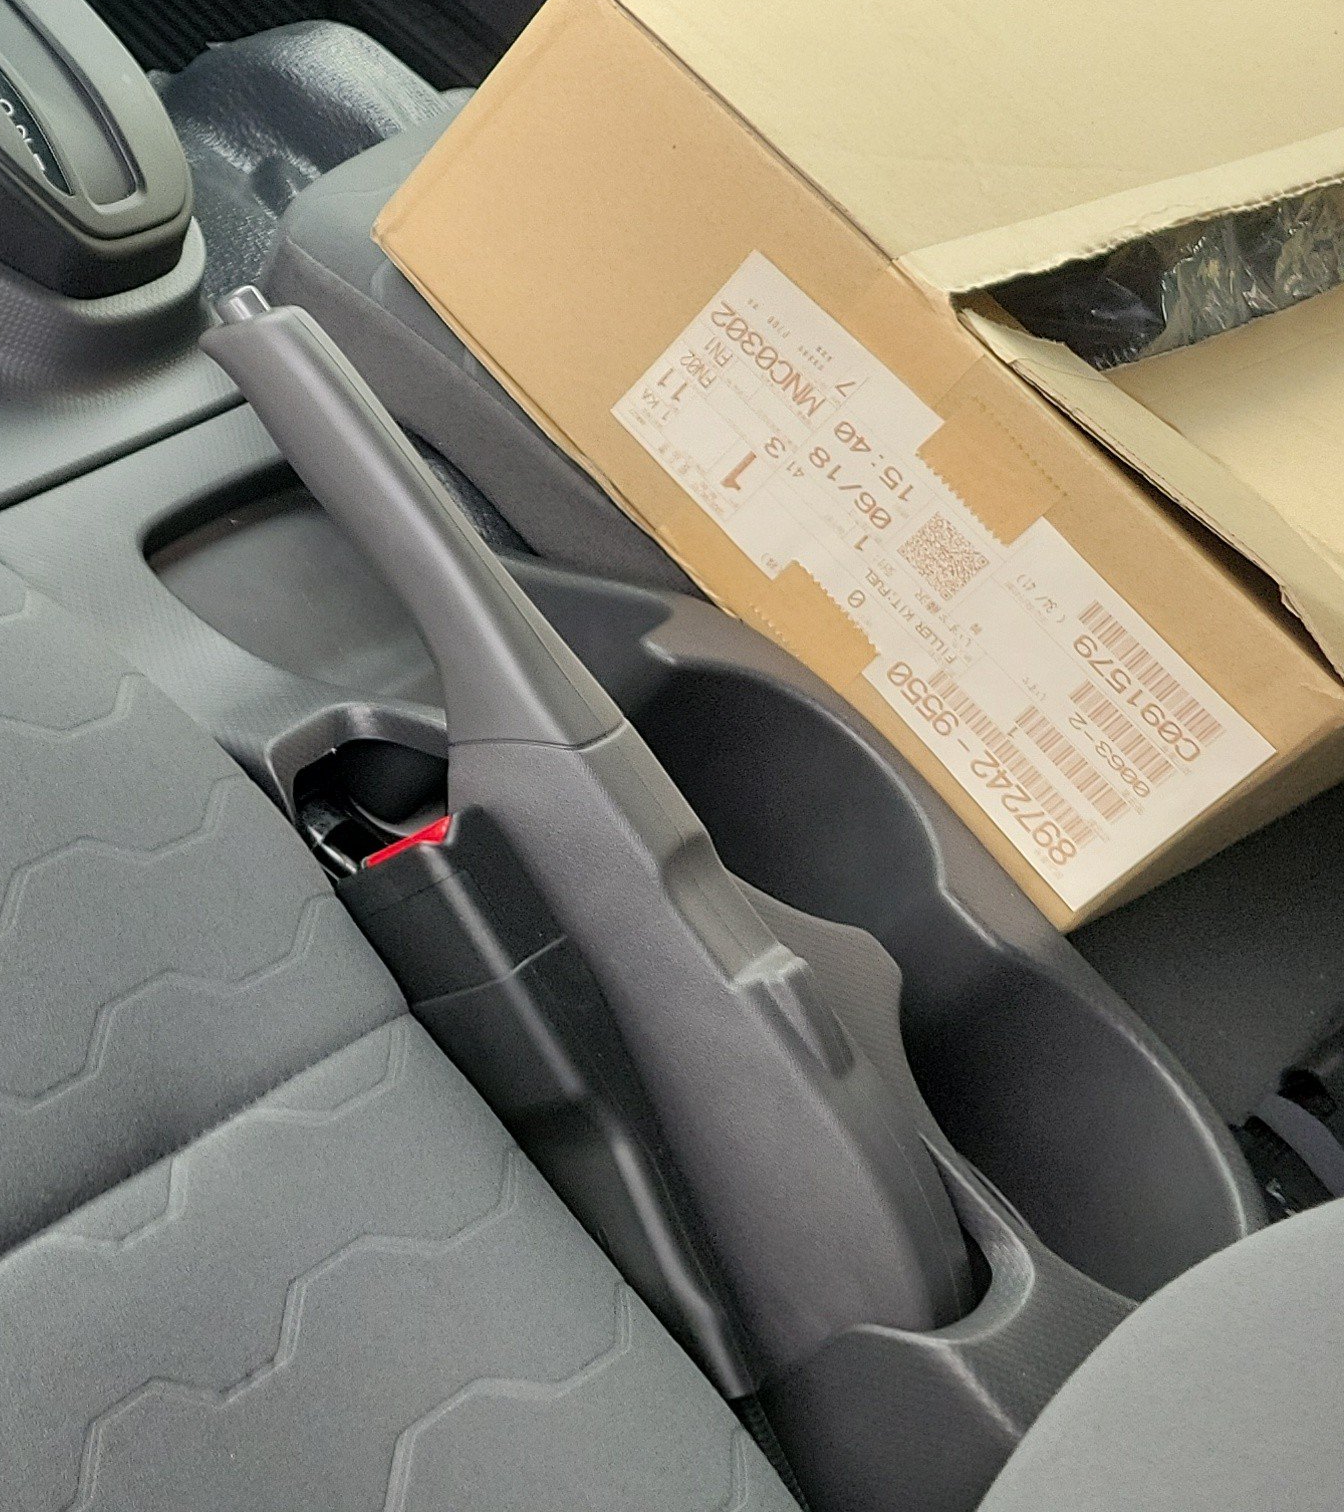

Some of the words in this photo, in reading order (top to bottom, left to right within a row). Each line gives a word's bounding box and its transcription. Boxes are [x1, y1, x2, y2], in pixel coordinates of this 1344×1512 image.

[677, 348, 717, 389] FN02
[707, 298, 826, 418] MNC0302
[834, 373, 857, 397] 7
[762, 434, 787, 460] 3
[831, 418, 917, 503] 15:40
[720, 450, 764, 496] 1
[785, 460, 805, 480] 41
[806, 443, 893, 532] 06/18
[853, 534, 872, 552] 1
[913, 620, 957, 665] FILLER
[1069, 632, 1205, 764] C091579
[1065, 711, 1153, 799] 0063-2
